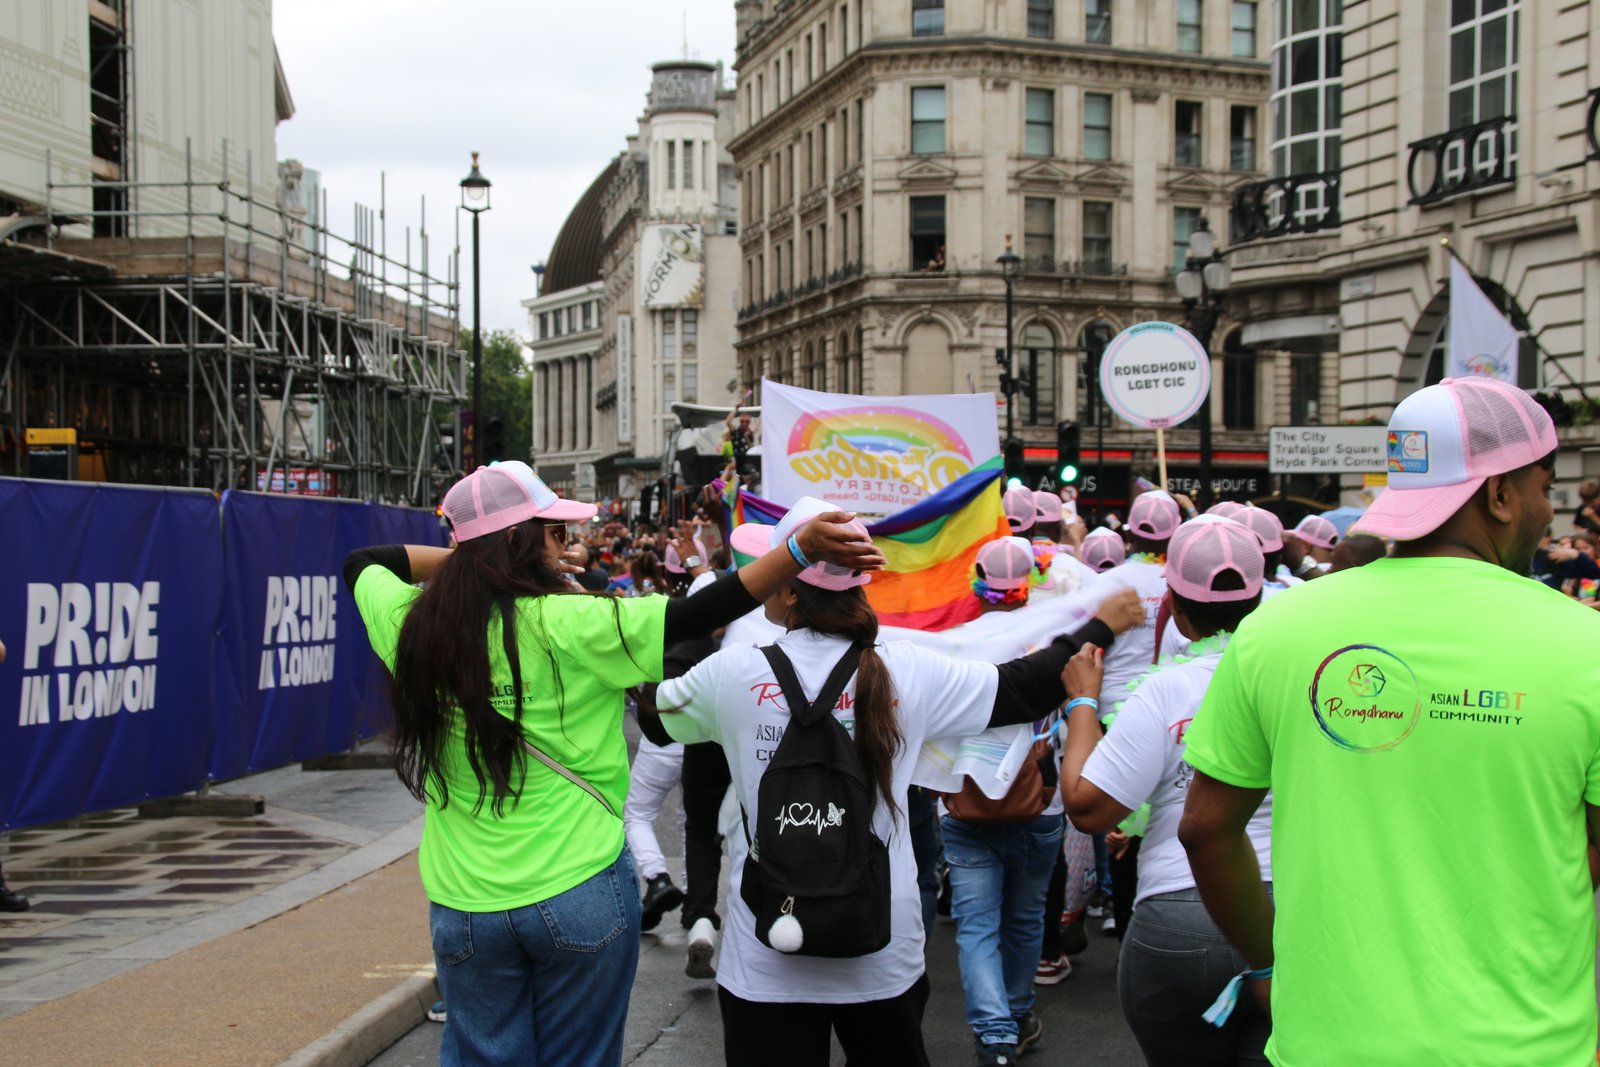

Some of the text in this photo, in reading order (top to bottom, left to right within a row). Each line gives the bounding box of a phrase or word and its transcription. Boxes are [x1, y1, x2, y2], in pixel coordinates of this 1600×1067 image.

[1114, 360, 1197, 377] RONGDHONU
[1128, 376, 1186, 391] LGBT CIC
[1275, 431, 1327, 443] The City
[1275, 443, 1379, 456] Trafalgar Square
[1275, 456, 1386, 469] Hyde Park Corner
[1167, 478, 1258, 491] STEAHOUE
[263, 575, 337, 645] PR!DE
[24, 581, 160, 669] PR!DE
[258, 644, 335, 690] IN LONDON
[18, 664, 156, 726] IN LONDON
[495, 681, 531, 697] LGT
[1430, 688, 1527, 711] ASIAN LGBT
[1324, 697, 1404, 723] Rongdhanu
[1429, 710, 1523, 725] COMMUNITY
[756, 724, 785, 741] ASIA
